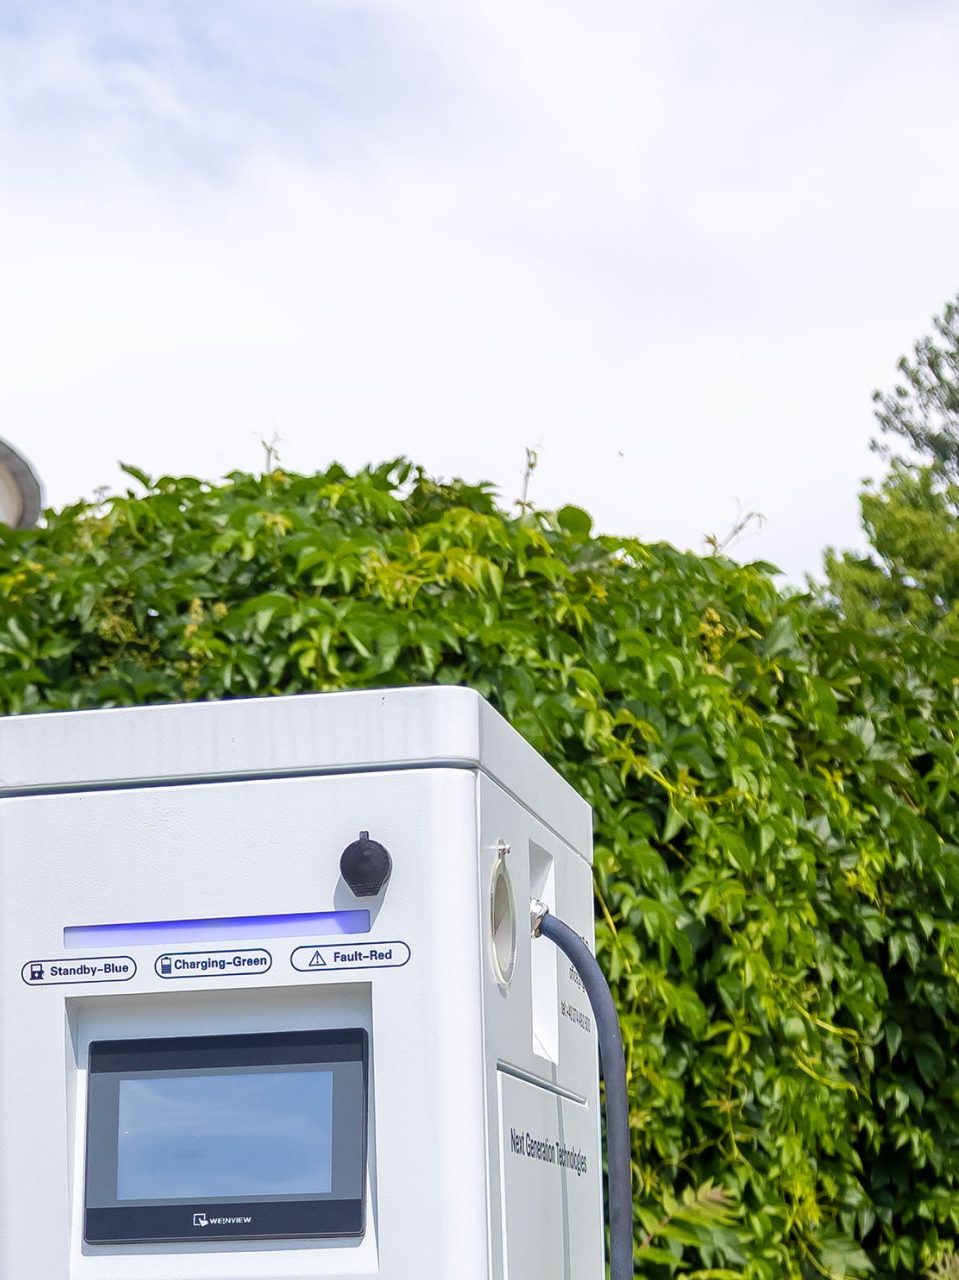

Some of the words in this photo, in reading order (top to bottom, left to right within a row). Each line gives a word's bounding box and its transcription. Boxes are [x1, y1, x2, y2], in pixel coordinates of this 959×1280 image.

[174, 956, 268, 972] Charging-Green
[333, 950, 393, 963] Fault-Red
[50, 963, 129, 979] Standby-Blue
[510, 1128, 525, 1156] Next
[526, 1132, 556, 1164] Generation
[556, 1141, 587, 1176] Technologies
